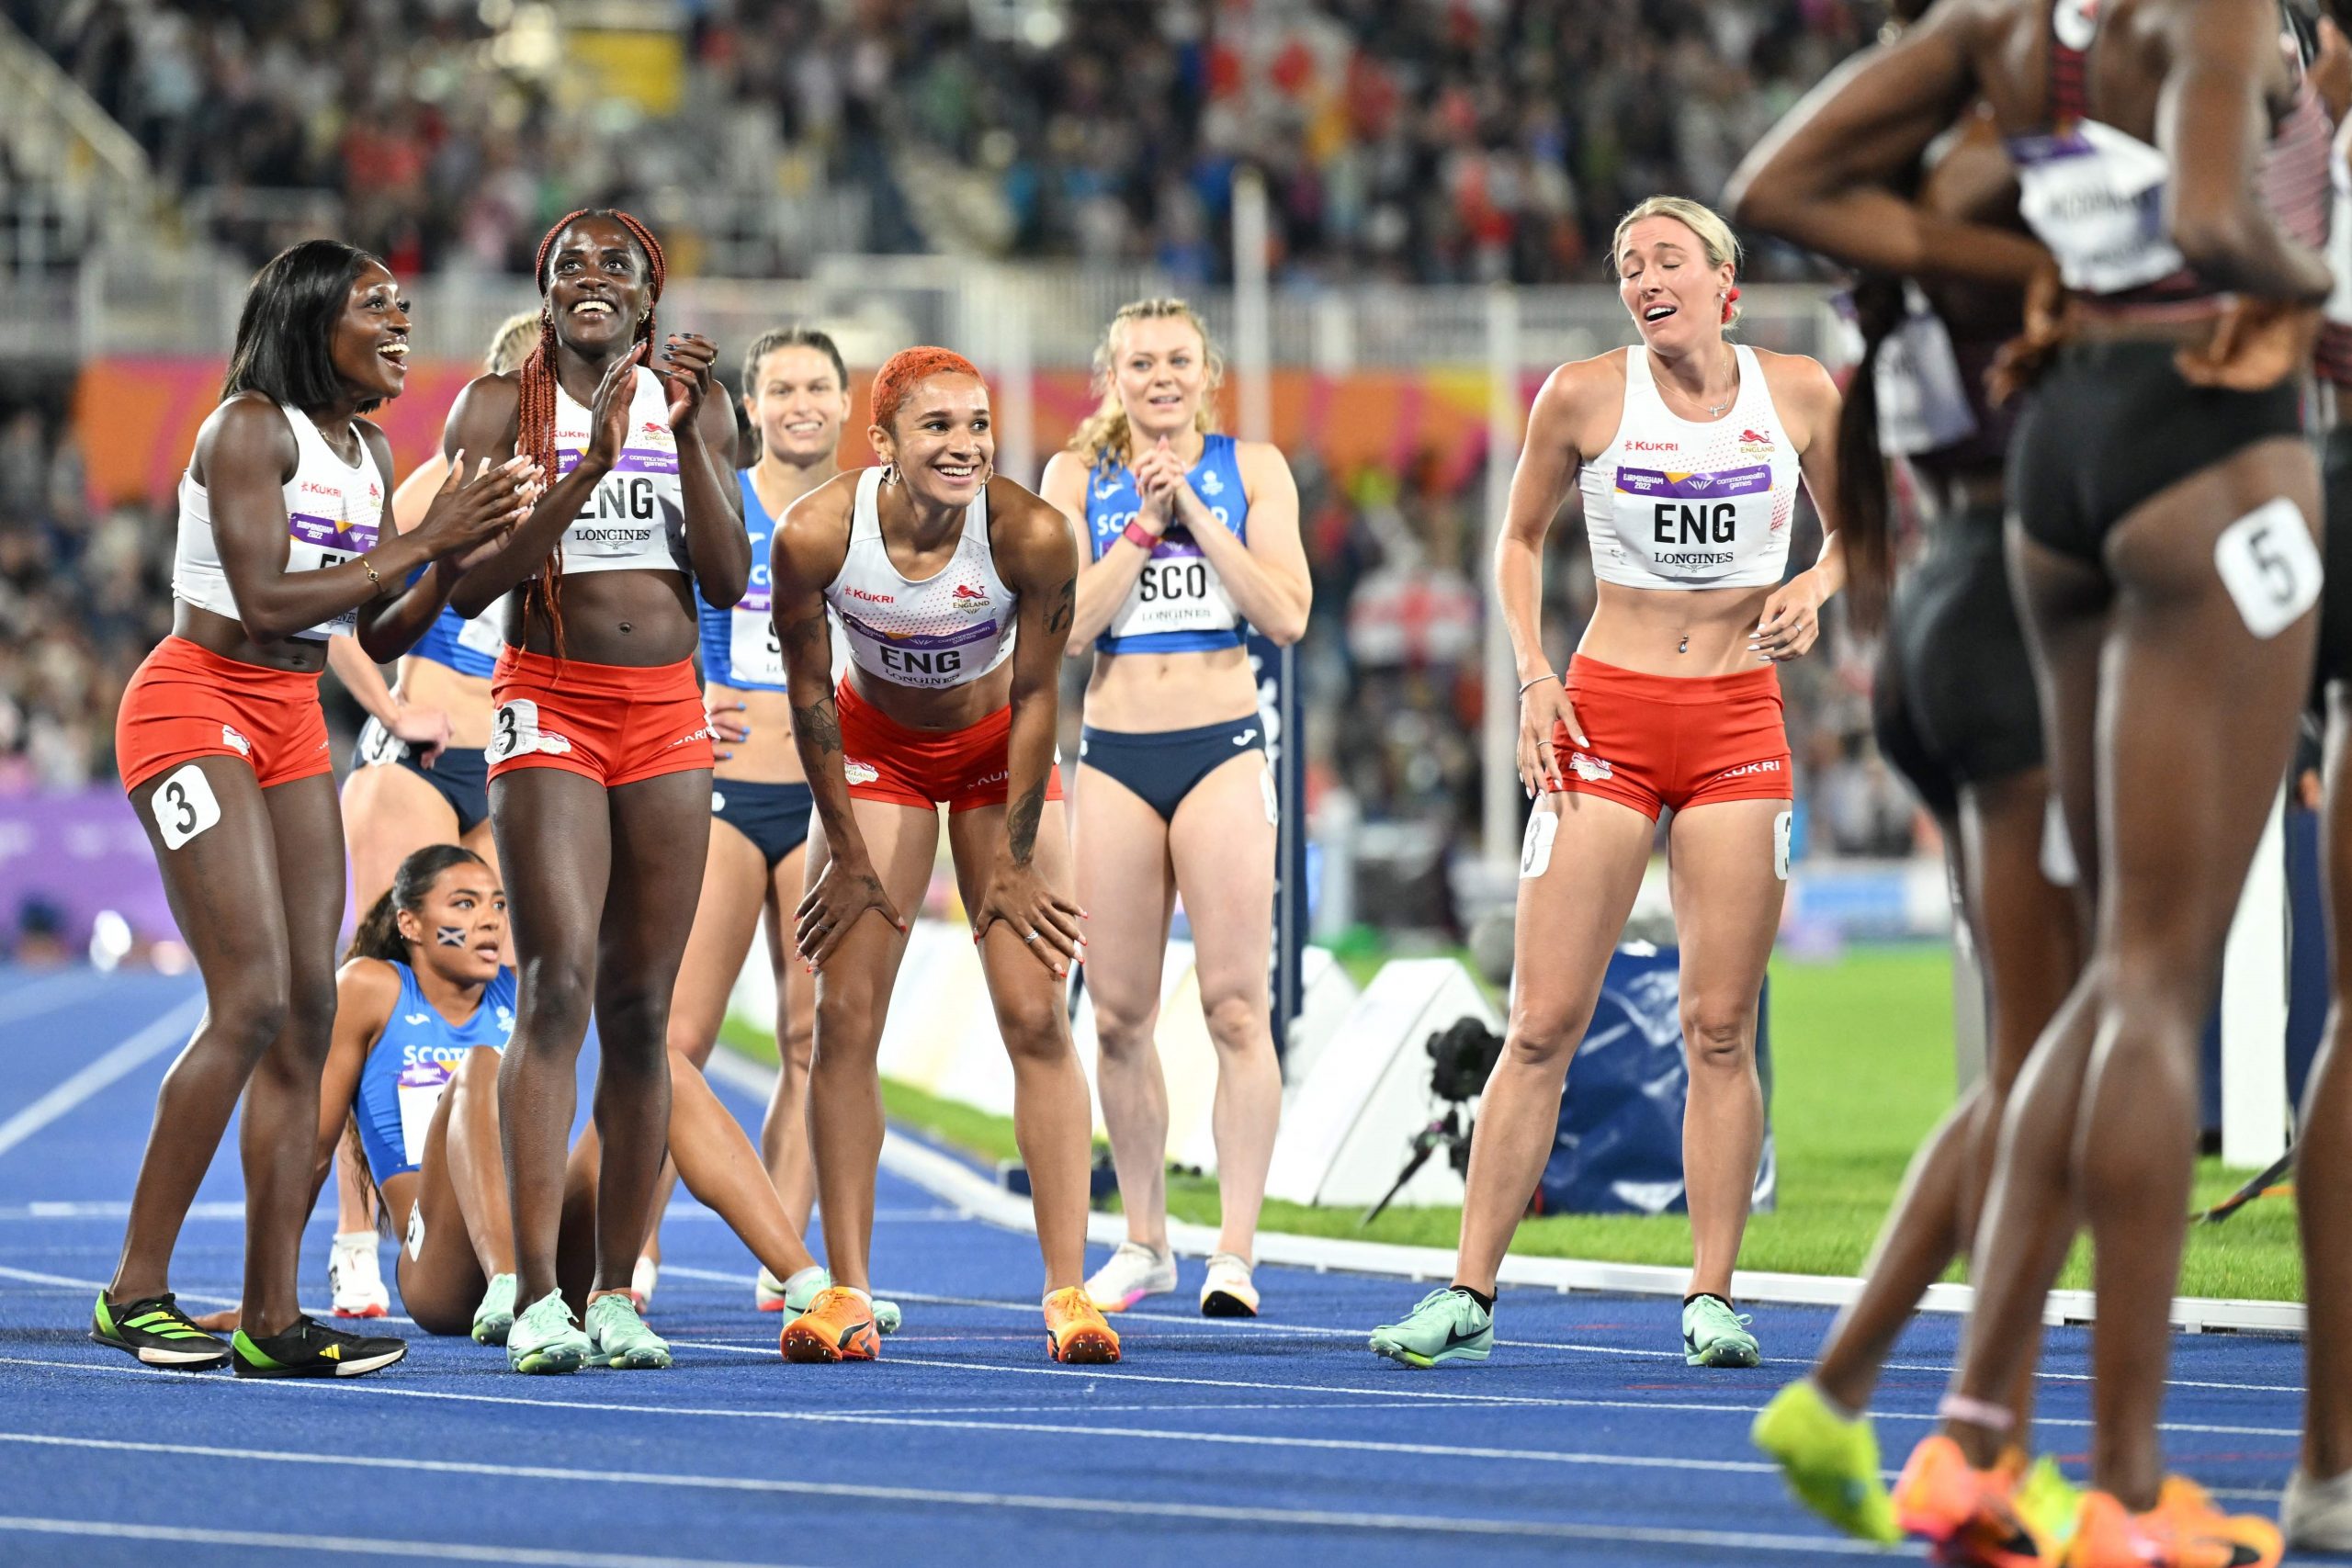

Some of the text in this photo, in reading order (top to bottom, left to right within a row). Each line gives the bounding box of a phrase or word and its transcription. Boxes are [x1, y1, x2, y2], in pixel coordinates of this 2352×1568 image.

[1635, 441, 1679, 451] KUKRI
[1740, 446, 1775, 454] ENGLAND
[1623, 473, 1664, 485] BIRMINGHAM
[1634, 480, 1653, 491] 2022
[1716, 470, 1766, 486] commonwealth
[1729, 479, 1753, 490] games
[311, 483, 342, 498] KUKRI
[1654, 502, 1736, 545] ENG
[575, 529, 651, 541] LONGINES
[1655, 552, 1734, 565] LONGINES
[2249, 526, 2299, 607] 5
[1139, 563, 1206, 602] SCO
[854, 588, 894, 604] KUKRI
[953, 600, 990, 609] ENGLAND
[1142, 609, 1212, 622] LONGINES
[879, 645, 961, 674] ENG
[886, 668, 960, 685] LONGINES
[499, 706, 518, 756] 3
[166, 781, 198, 835] 3
[1523, 817, 1542, 874] 3
